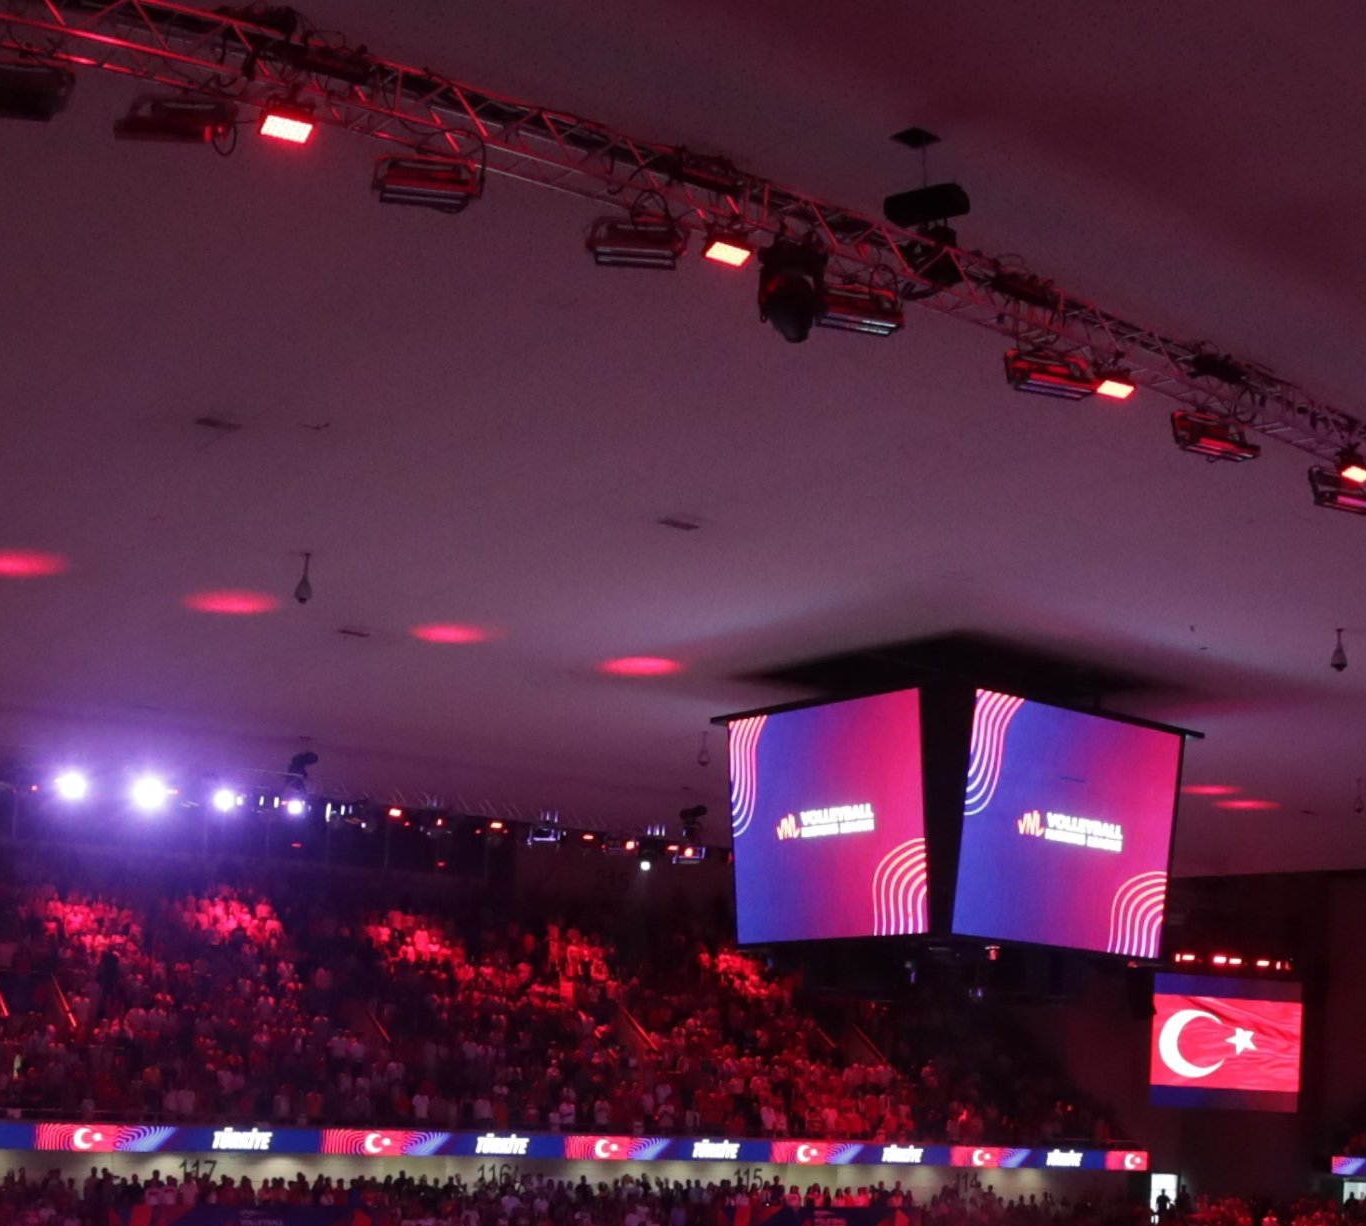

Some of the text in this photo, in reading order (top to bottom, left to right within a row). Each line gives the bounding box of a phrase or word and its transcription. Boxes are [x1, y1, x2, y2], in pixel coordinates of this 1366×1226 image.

[800, 803, 874, 827] VOLLEYBALL
[1046, 812, 1123, 841] VOLLEYBALL
[212, 1127, 272, 1151] TÜRKİYE
[476, 1133, 529, 1155] TÜRKİYE
[179, 1159, 217, 1182] 117
[734, 1168, 763, 1190] 115
